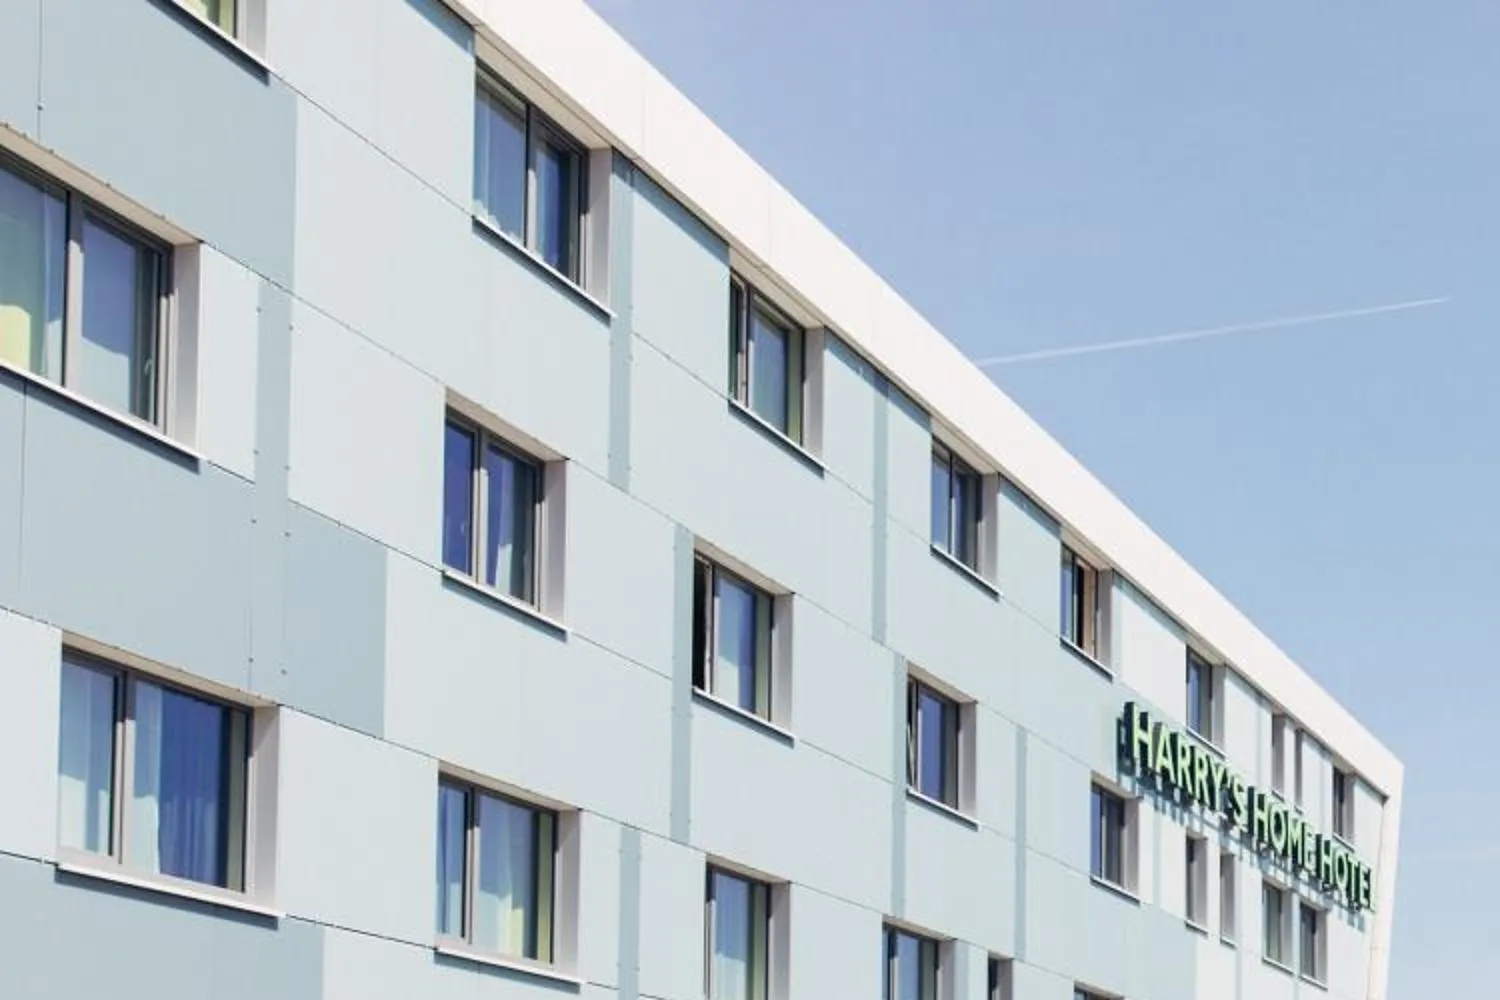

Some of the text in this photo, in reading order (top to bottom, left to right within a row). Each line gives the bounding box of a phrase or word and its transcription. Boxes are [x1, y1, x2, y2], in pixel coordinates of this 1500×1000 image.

[1131, 702, 1376, 915] HARRY'S HOME HOTEL
